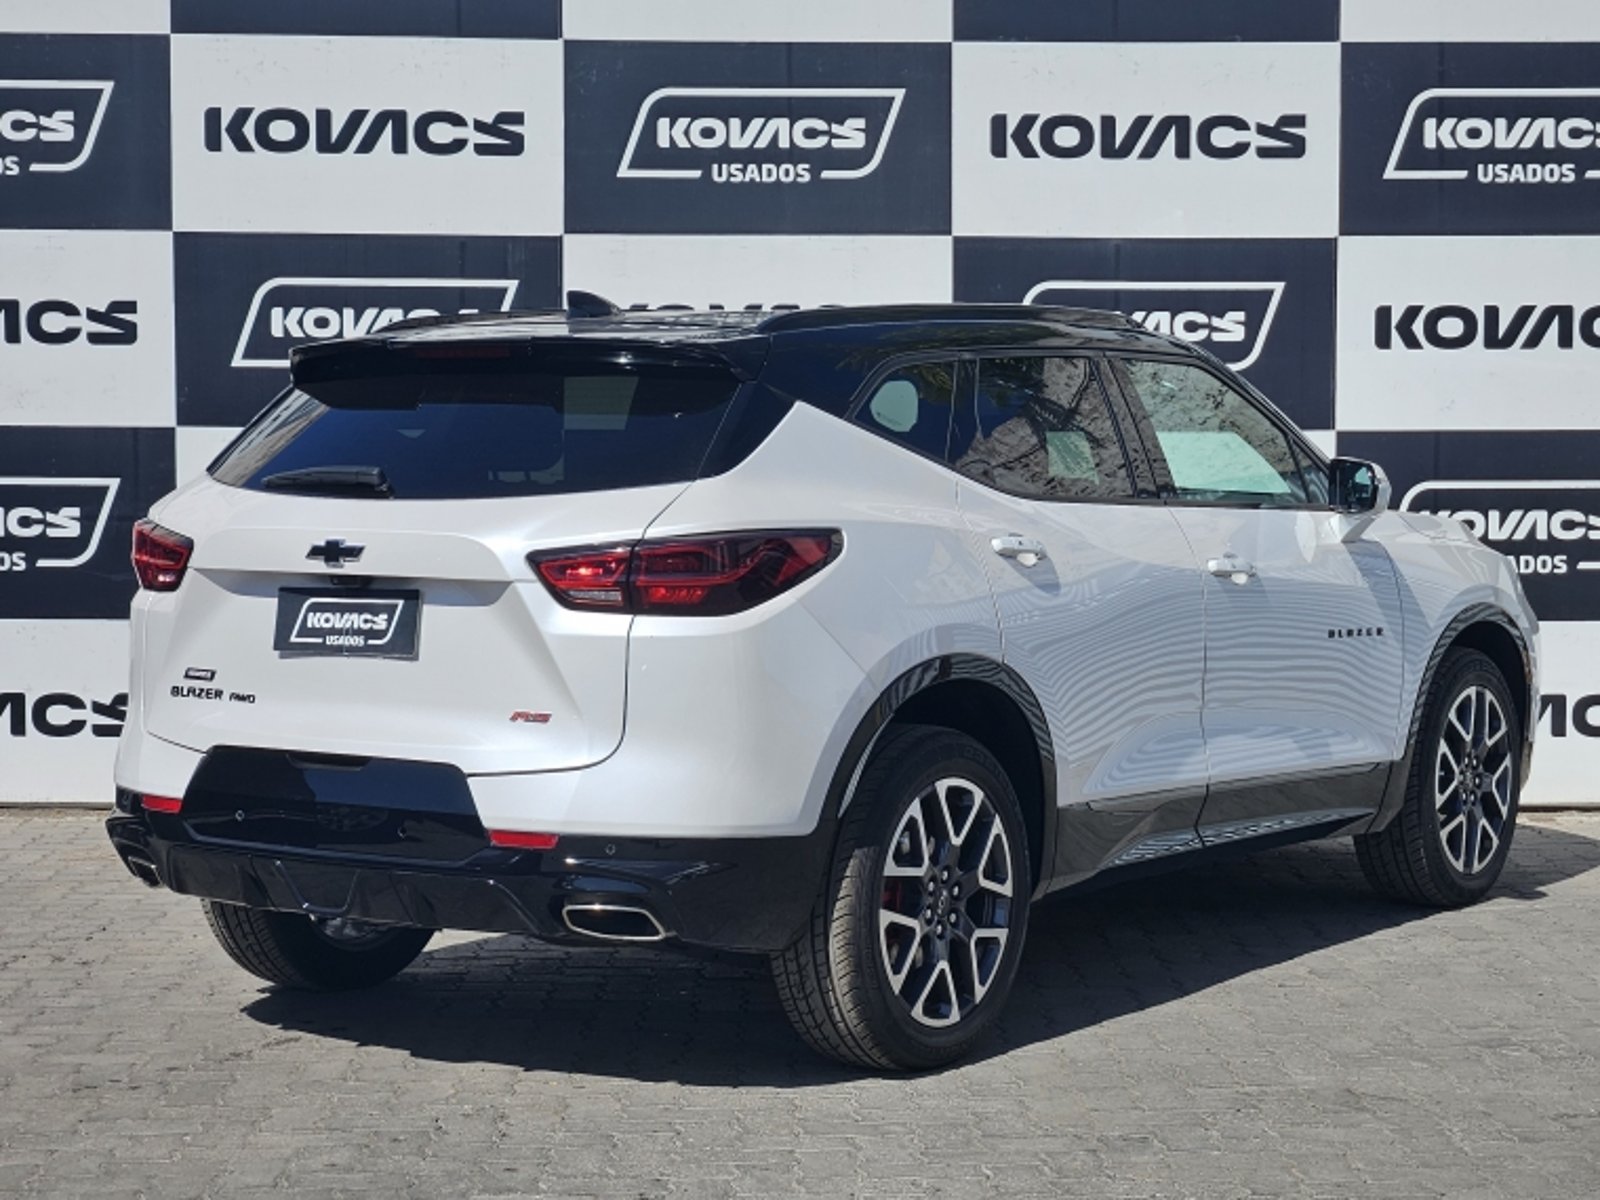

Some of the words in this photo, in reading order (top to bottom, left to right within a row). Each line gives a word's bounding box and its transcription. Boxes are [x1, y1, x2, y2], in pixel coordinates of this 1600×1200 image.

[204, 107, 525, 157] KOVACS
[656, 117, 867, 149] KOVACS
[990, 113, 1307, 160] KOVACS
[1423, 117, 1600, 149] KOVAC
[0, 155, 20, 176] S
[711, 163, 811, 183] USADOS
[1477, 163, 1576, 184] USADOS
[270, 306, 480, 340] KOVA
[0, 506, 81, 538] CS
[1420, 509, 1600, 541] OVAC
[306, 611, 389, 631] KOVACS
[1327, 626, 1385, 639] BLAZER
[325, 634, 366, 647] USADOS
[169, 685, 224, 701] BLAZER
